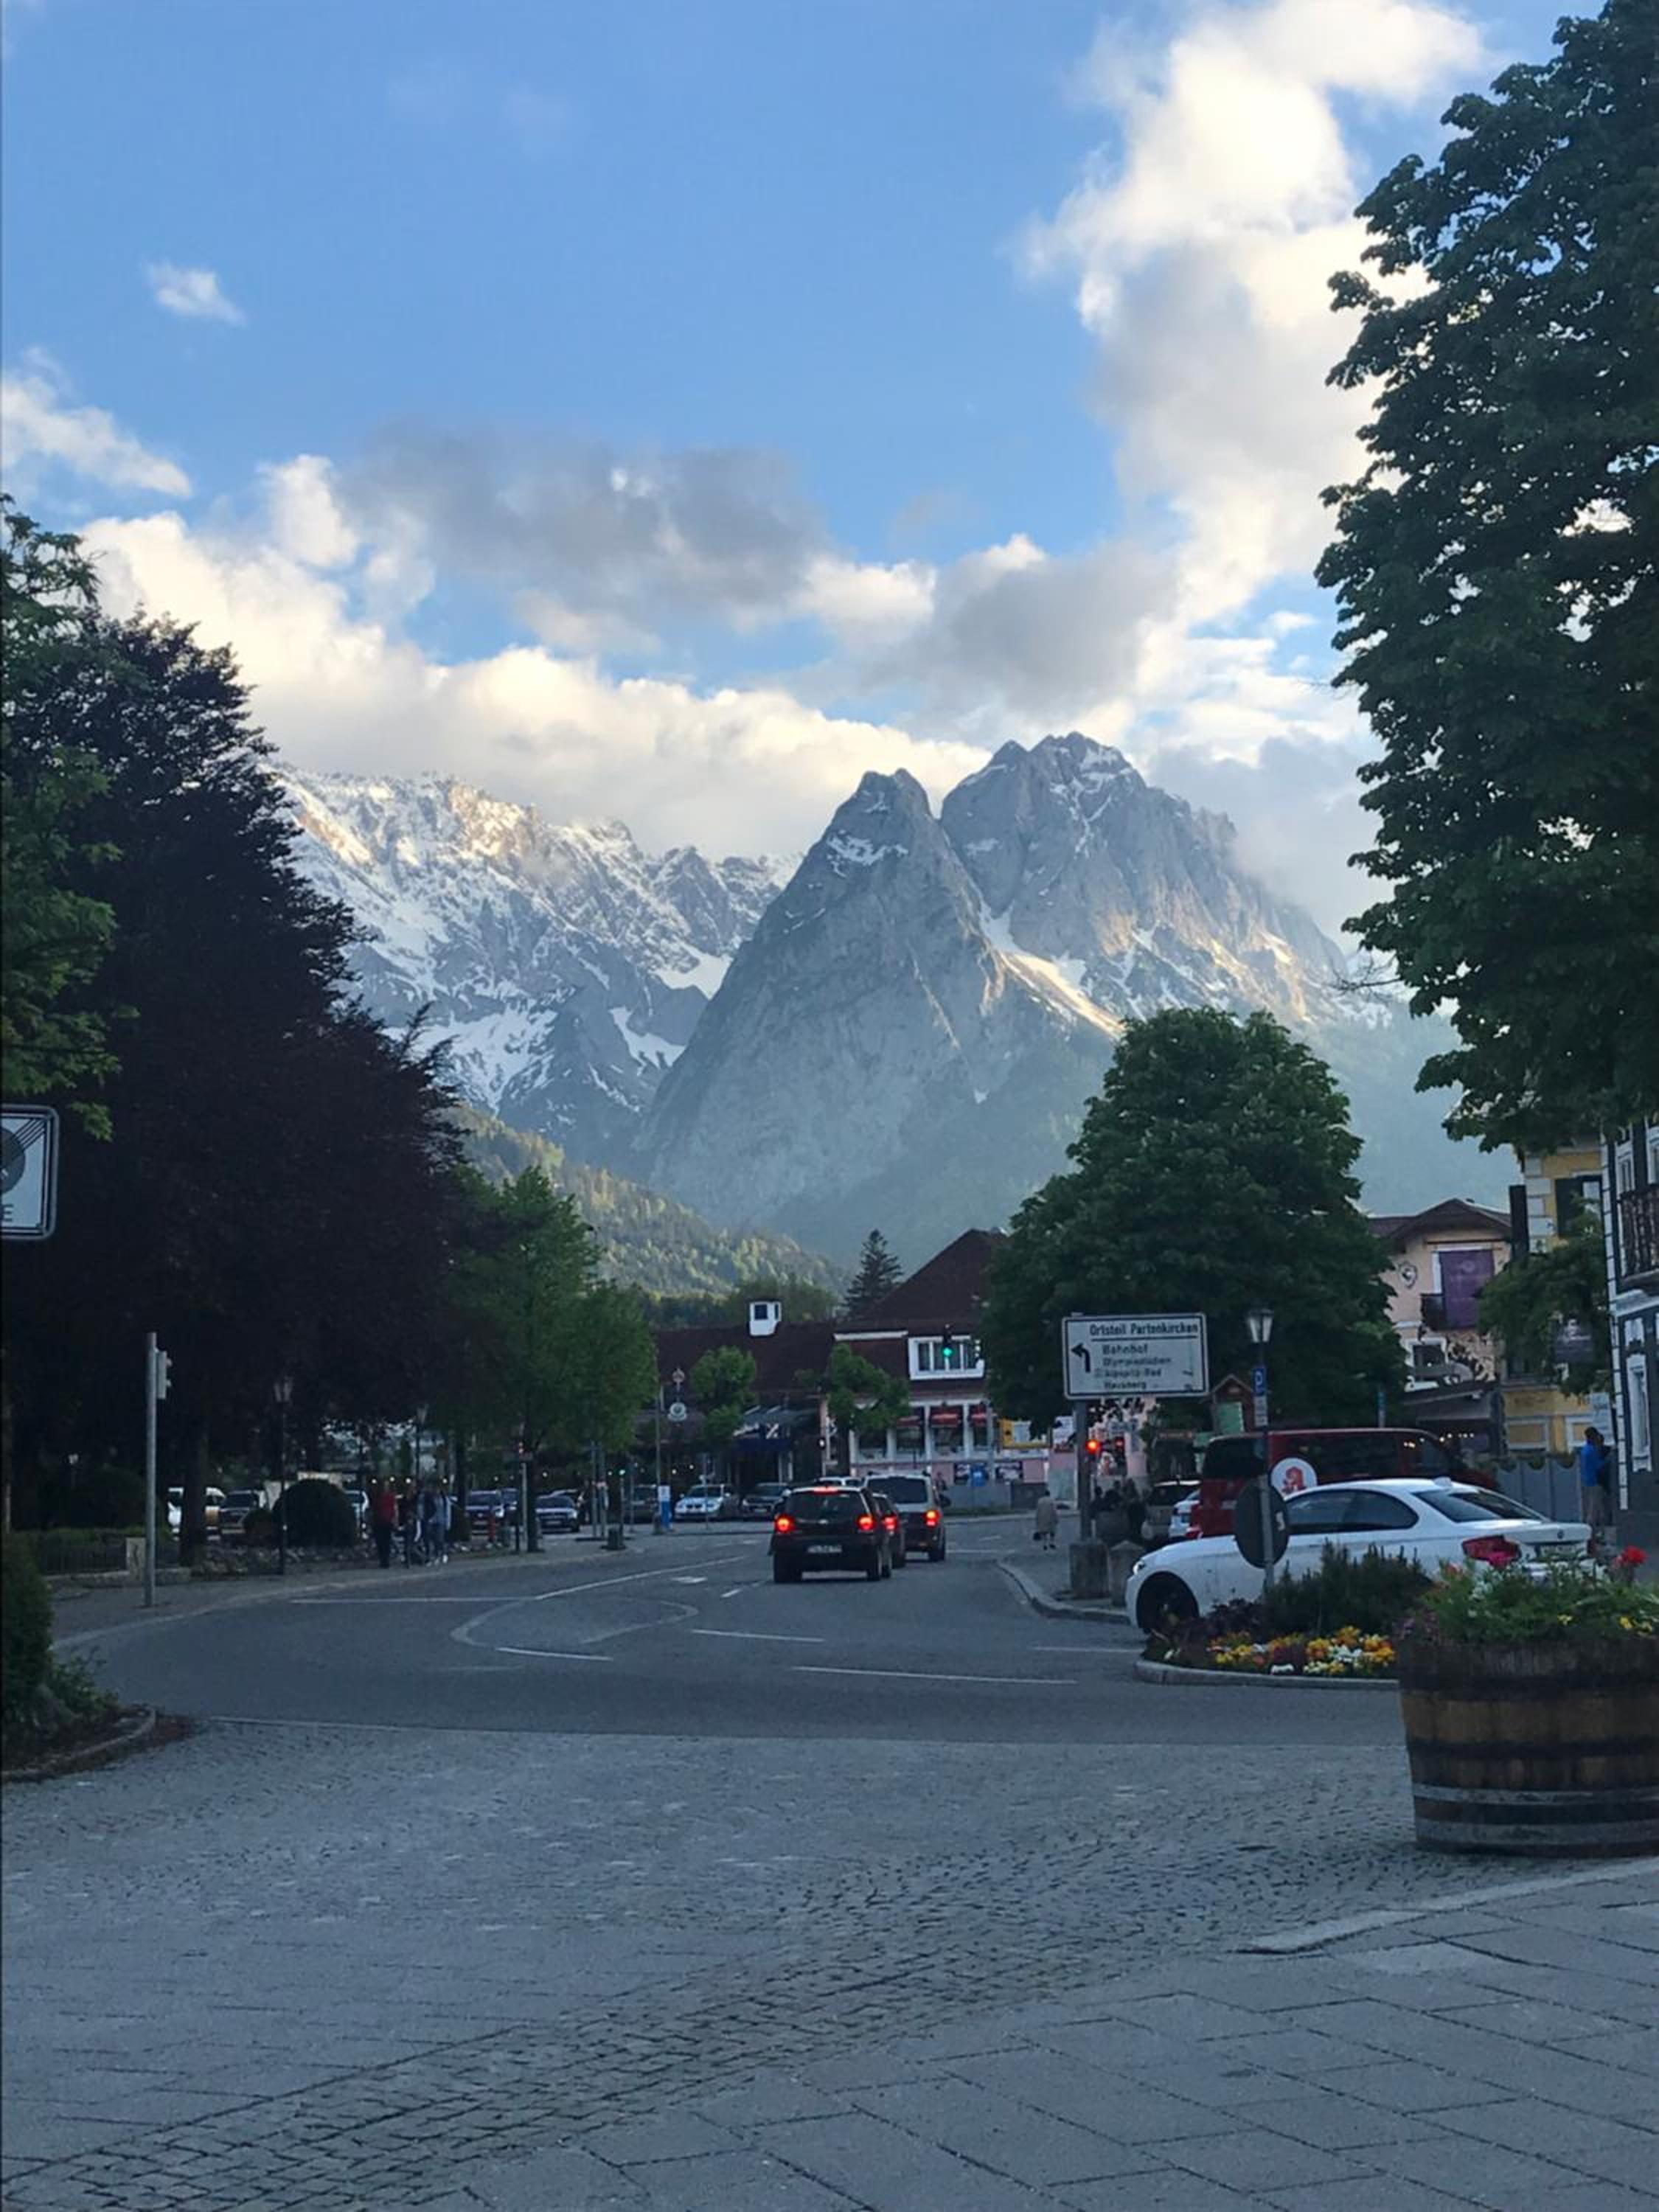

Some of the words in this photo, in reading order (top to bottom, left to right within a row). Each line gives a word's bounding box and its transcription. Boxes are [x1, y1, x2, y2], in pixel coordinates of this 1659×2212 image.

[1090, 1324, 1126, 1335] Ortsteil
[1131, 1322, 1197, 1334] Partenkirchen
[1102, 1344, 1147, 1354] Bahnhof
